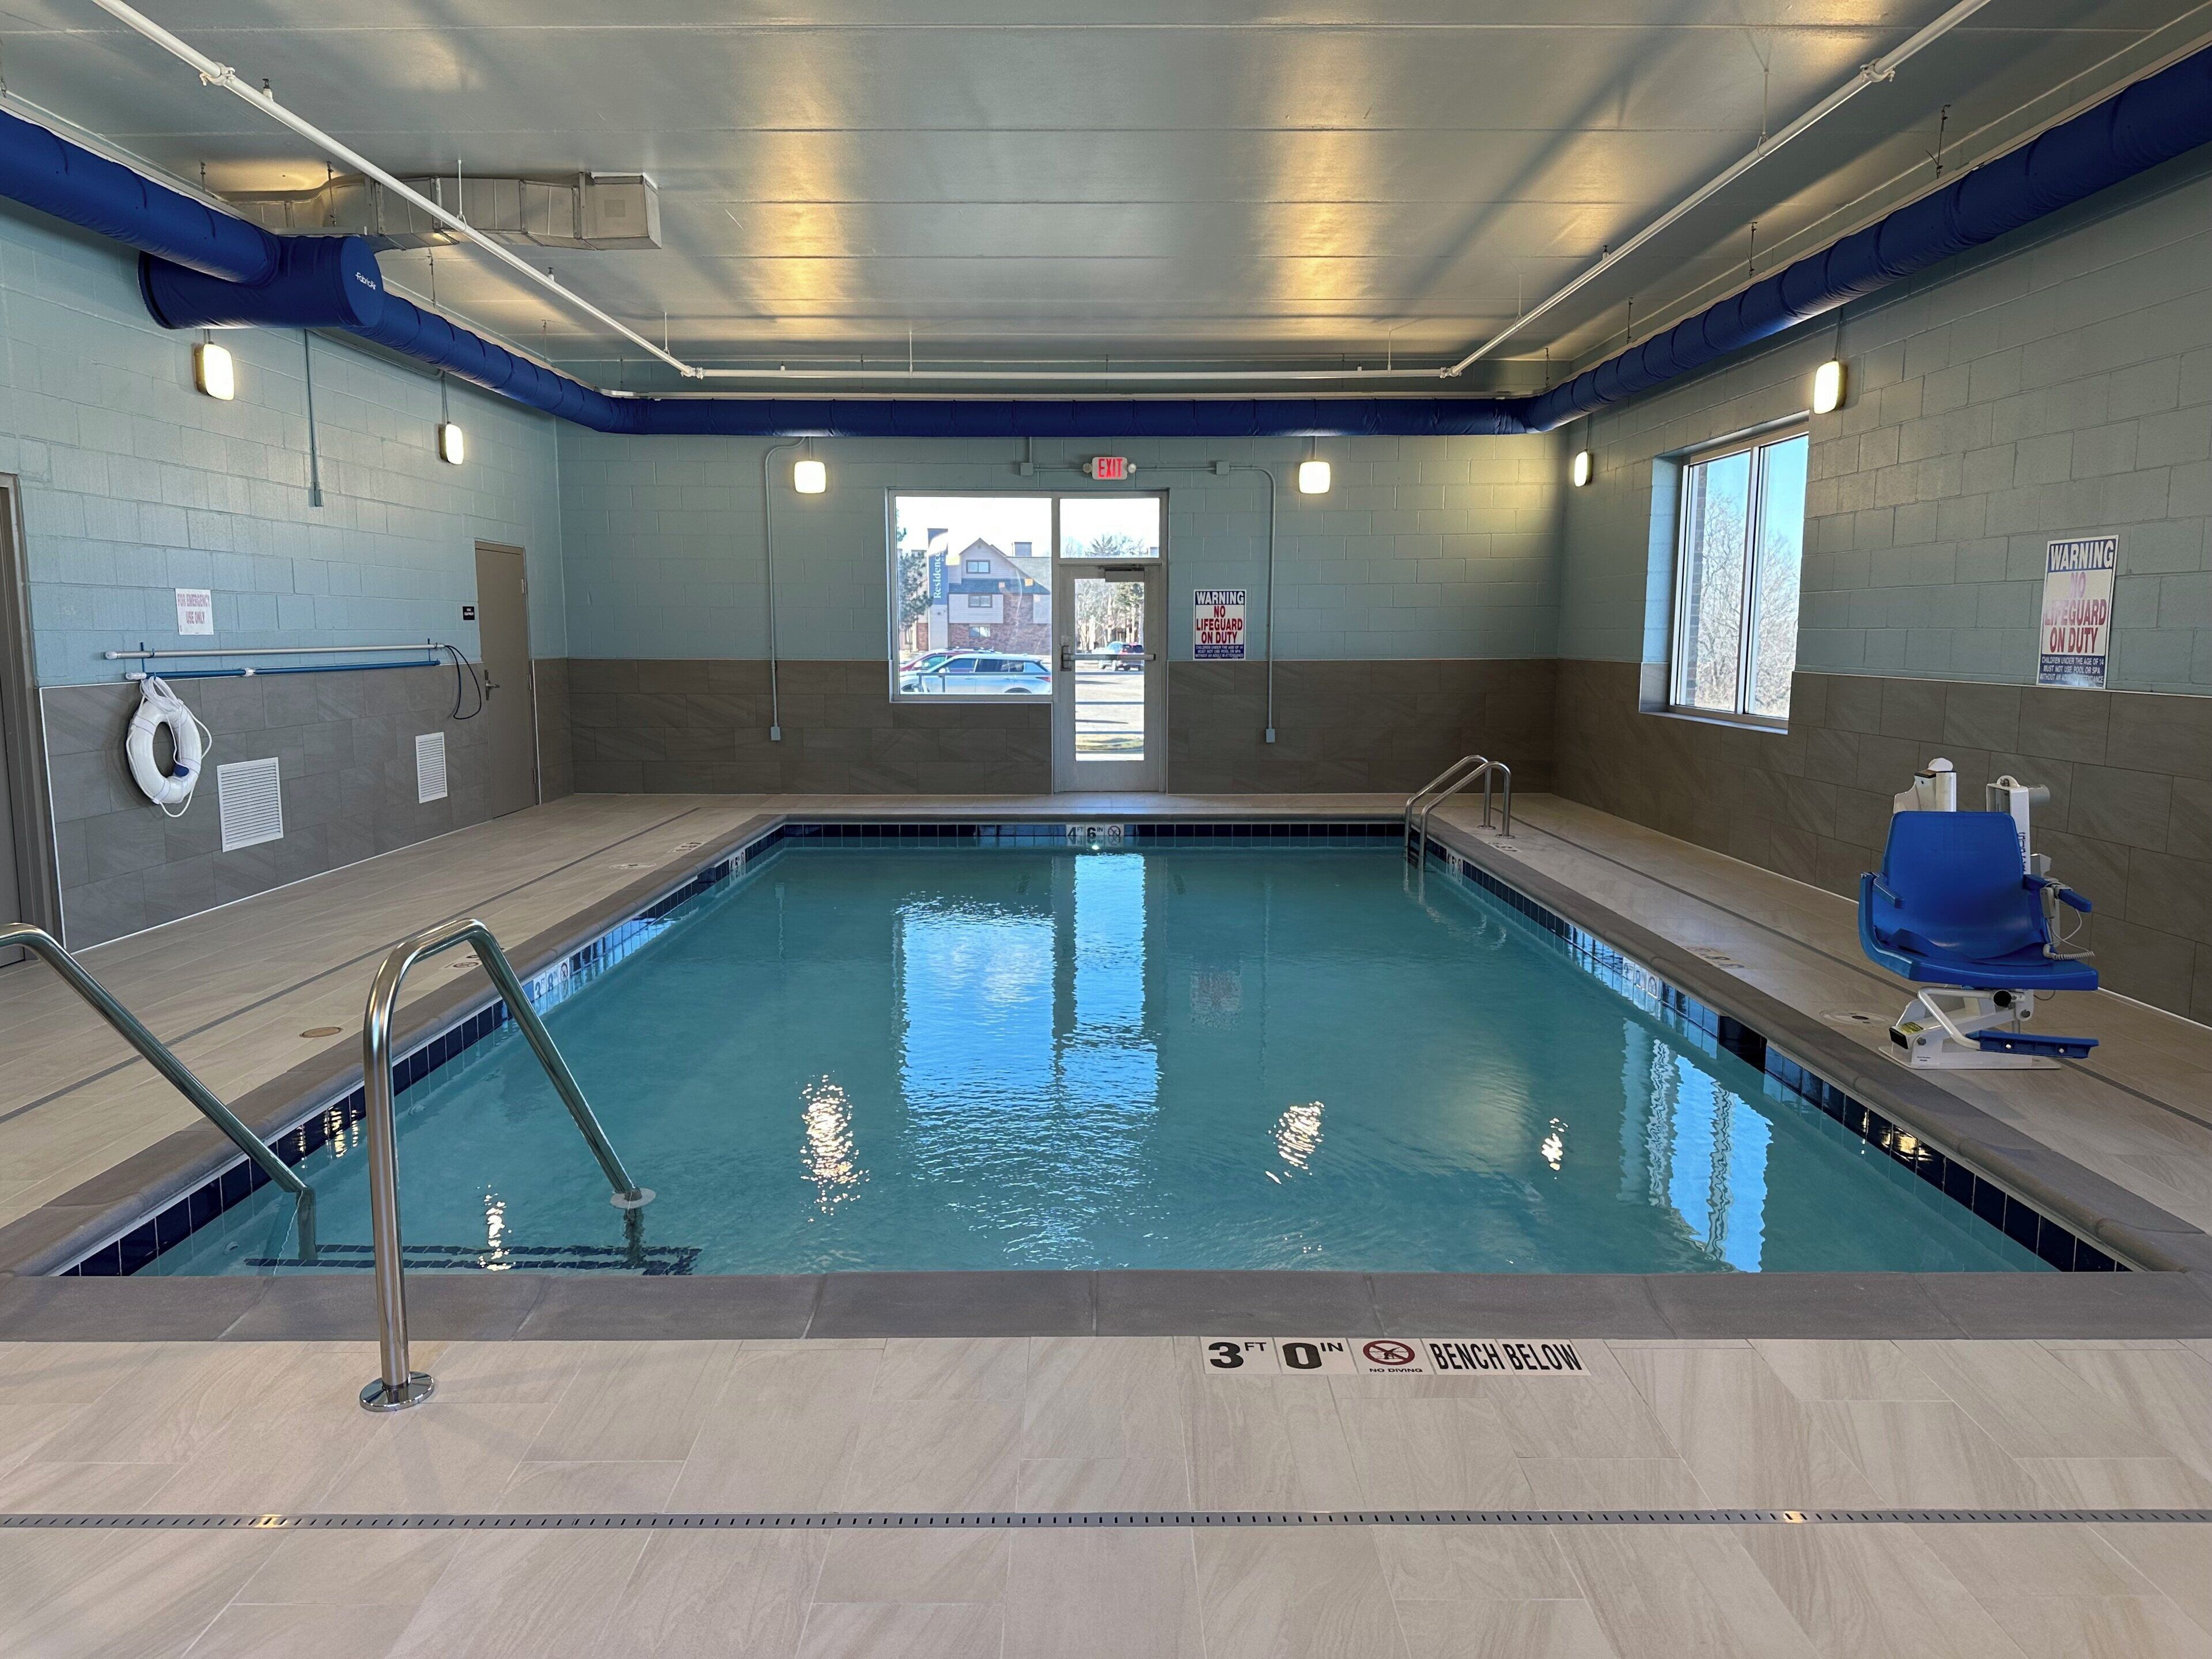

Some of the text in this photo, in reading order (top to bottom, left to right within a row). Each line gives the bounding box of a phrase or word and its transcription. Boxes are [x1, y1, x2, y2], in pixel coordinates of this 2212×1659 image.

[355, 272, 376, 290] FabricAir
[1099, 458, 1123, 478] EXIT
[2050, 540, 2114, 571] WARNING
[2070, 571, 2086, 599] NO
[1196, 592, 1244, 605] WARNING
[1214, 605, 1225, 618] NO
[2044, 599, 2107, 626] LIFEGUARD
[1196, 619, 1243, 631] LIFEGUARD
[1202, 632, 1237, 643] ON DUTY
[2050, 627, 2098, 653] ON DUTY
[1067, 827, 1076, 836] 4
[1087, 827, 1096, 837] 6
[1209, 1342, 1343, 1369] 3 FT 0 IN
[1429, 1343, 1582, 1370] BENCH BELOW
